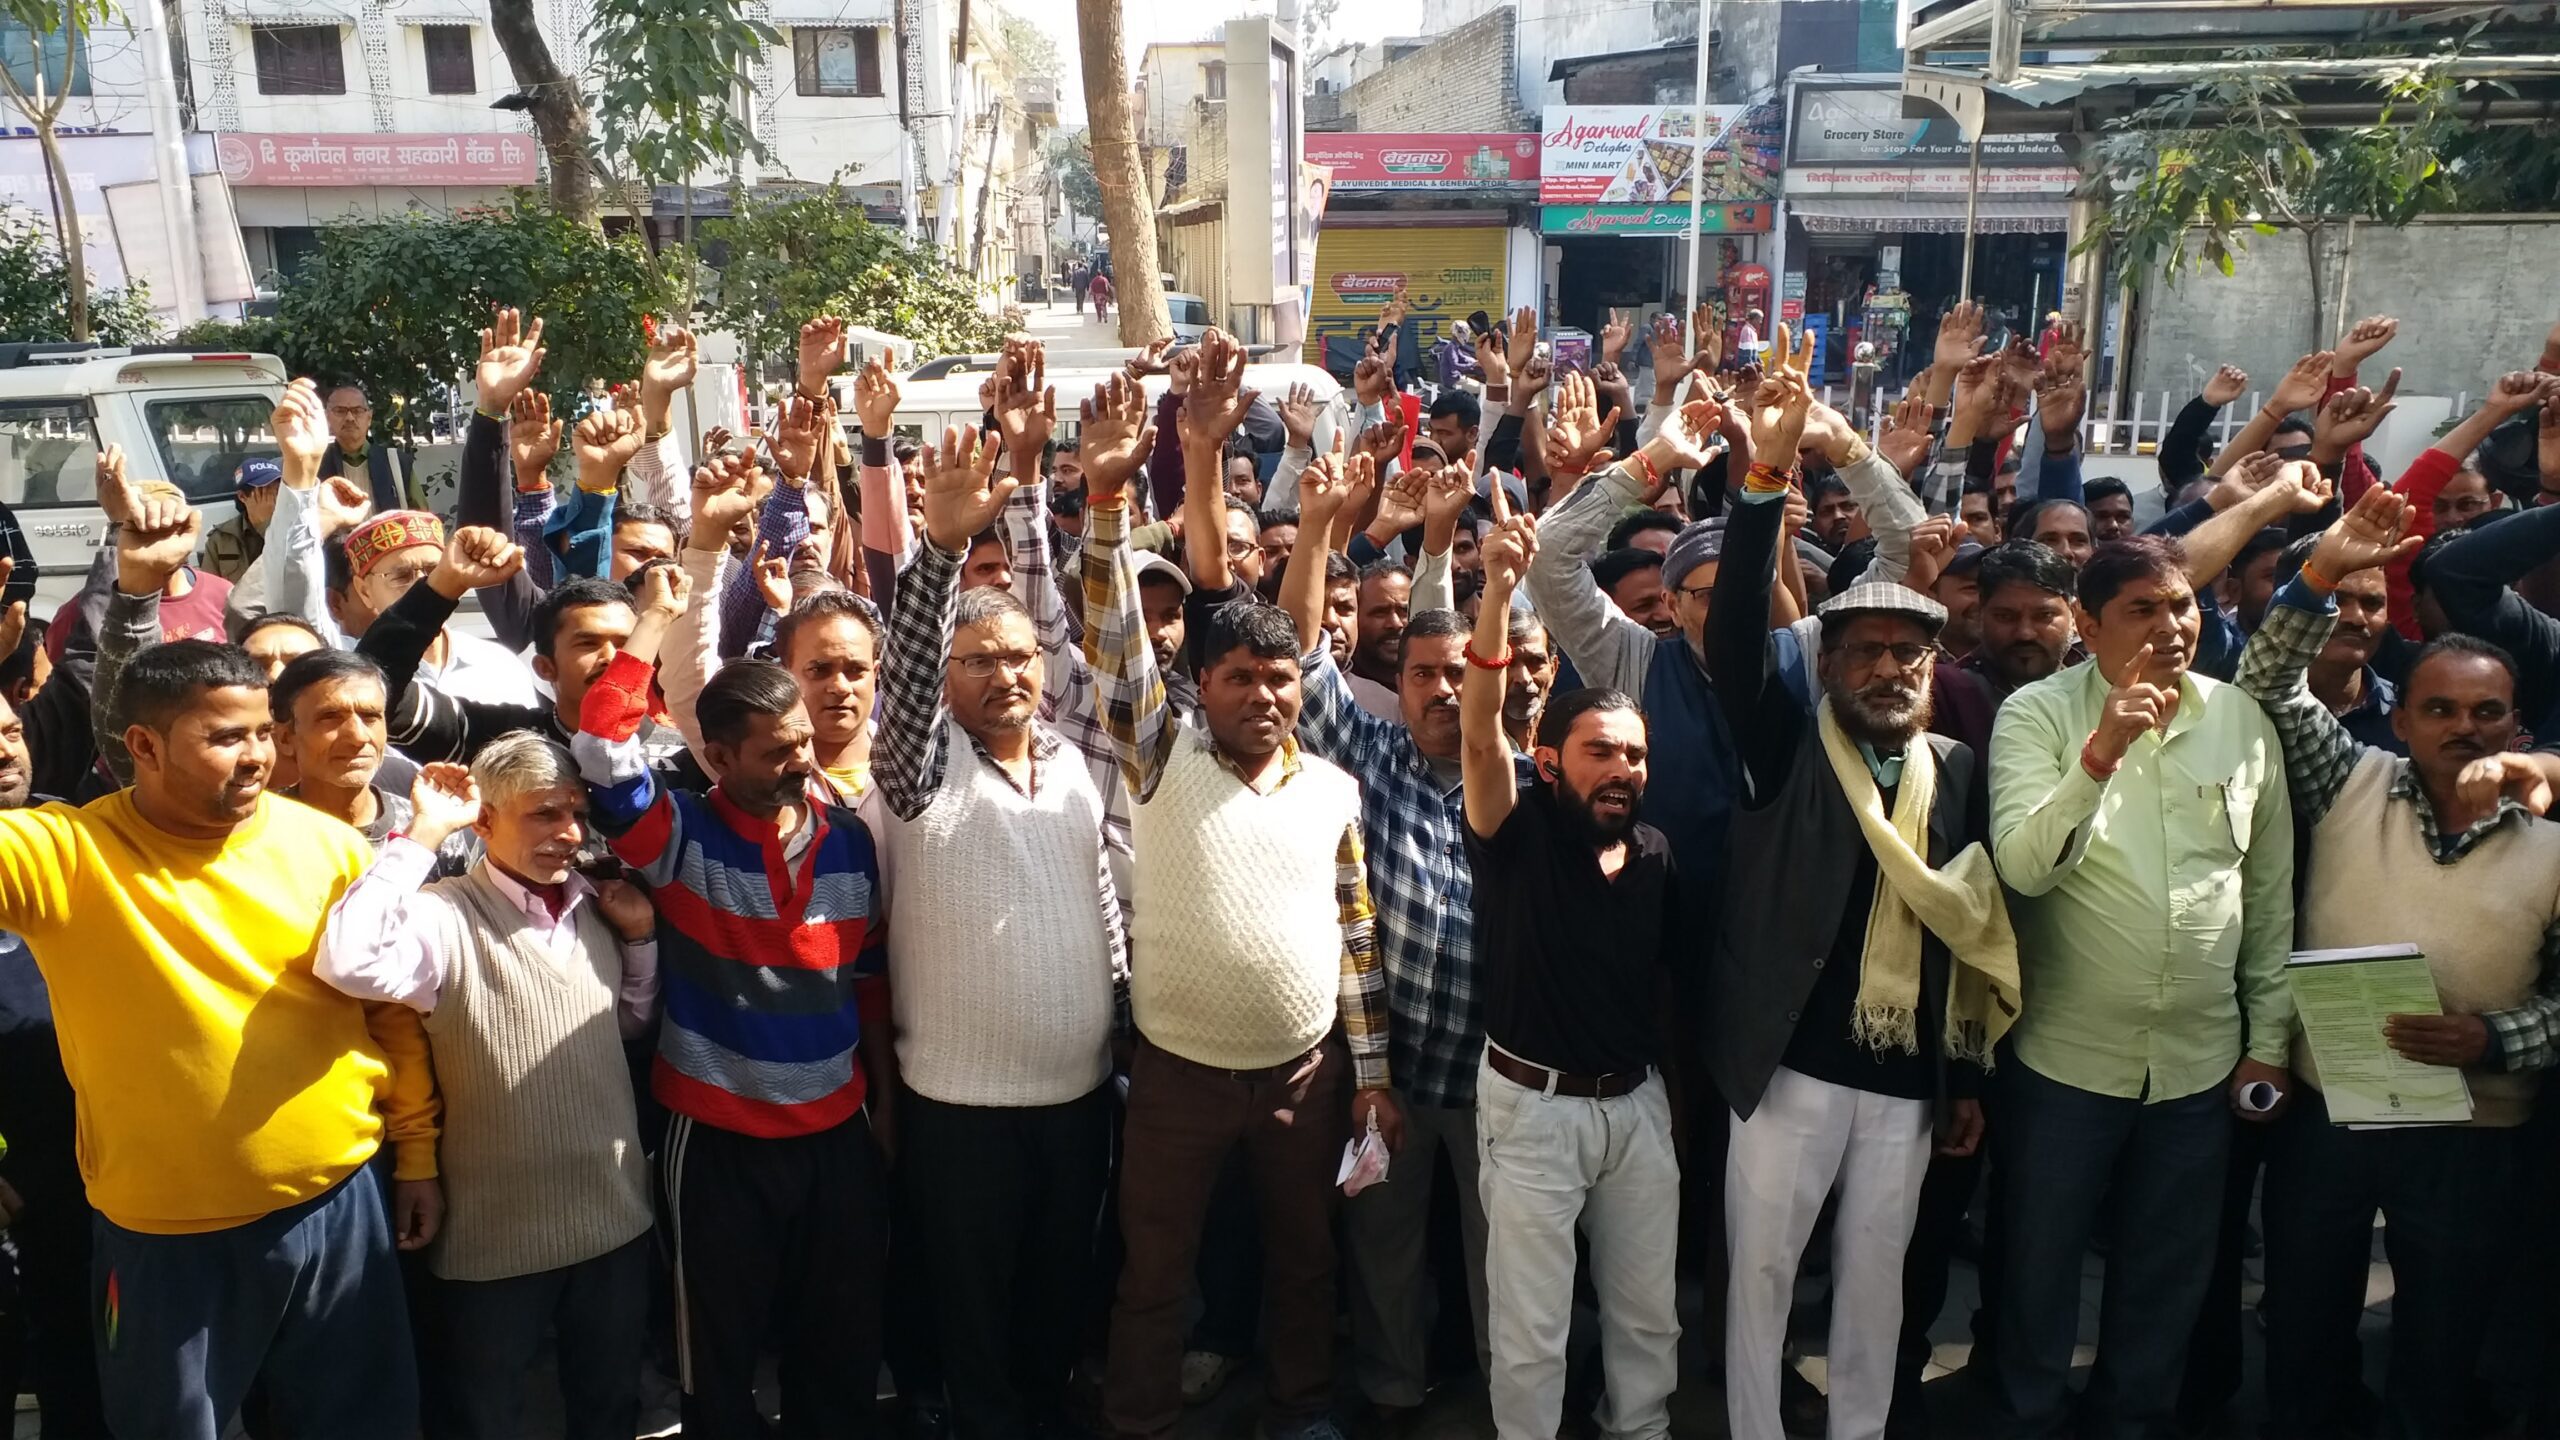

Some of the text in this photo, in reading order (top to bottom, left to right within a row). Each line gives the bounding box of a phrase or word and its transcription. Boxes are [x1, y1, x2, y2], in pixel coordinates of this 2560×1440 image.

[1543, 114, 1650, 150] Agarwal
[1824, 129, 1905, 142] Grocery Store
[260, 138, 277, 165] दि
[353, 146, 391, 165] नगर
[396, 137, 460, 165] सहकारी
[464, 137, 496, 165] बैंक
[1583, 140, 1632, 156] Delights
[1860, 144, 1880, 153] One
[1883, 144, 1907, 155] Stop
[1909, 144, 1926, 153] For
[1930, 144, 1953, 153] Your
[1955, 144, 1972, 153] Dai
[1983, 144, 2015, 153] Needs
[2018, 144, 2049, 153] Under
[1565, 161, 1622, 170] MINI MART
[1439, 179, 1479, 187] GENERAL
[1480, 179, 1509, 187] STORE
[1567, 207, 1706, 232] Agarwal Deligs
[34, 523, 90, 538] BOLERO
